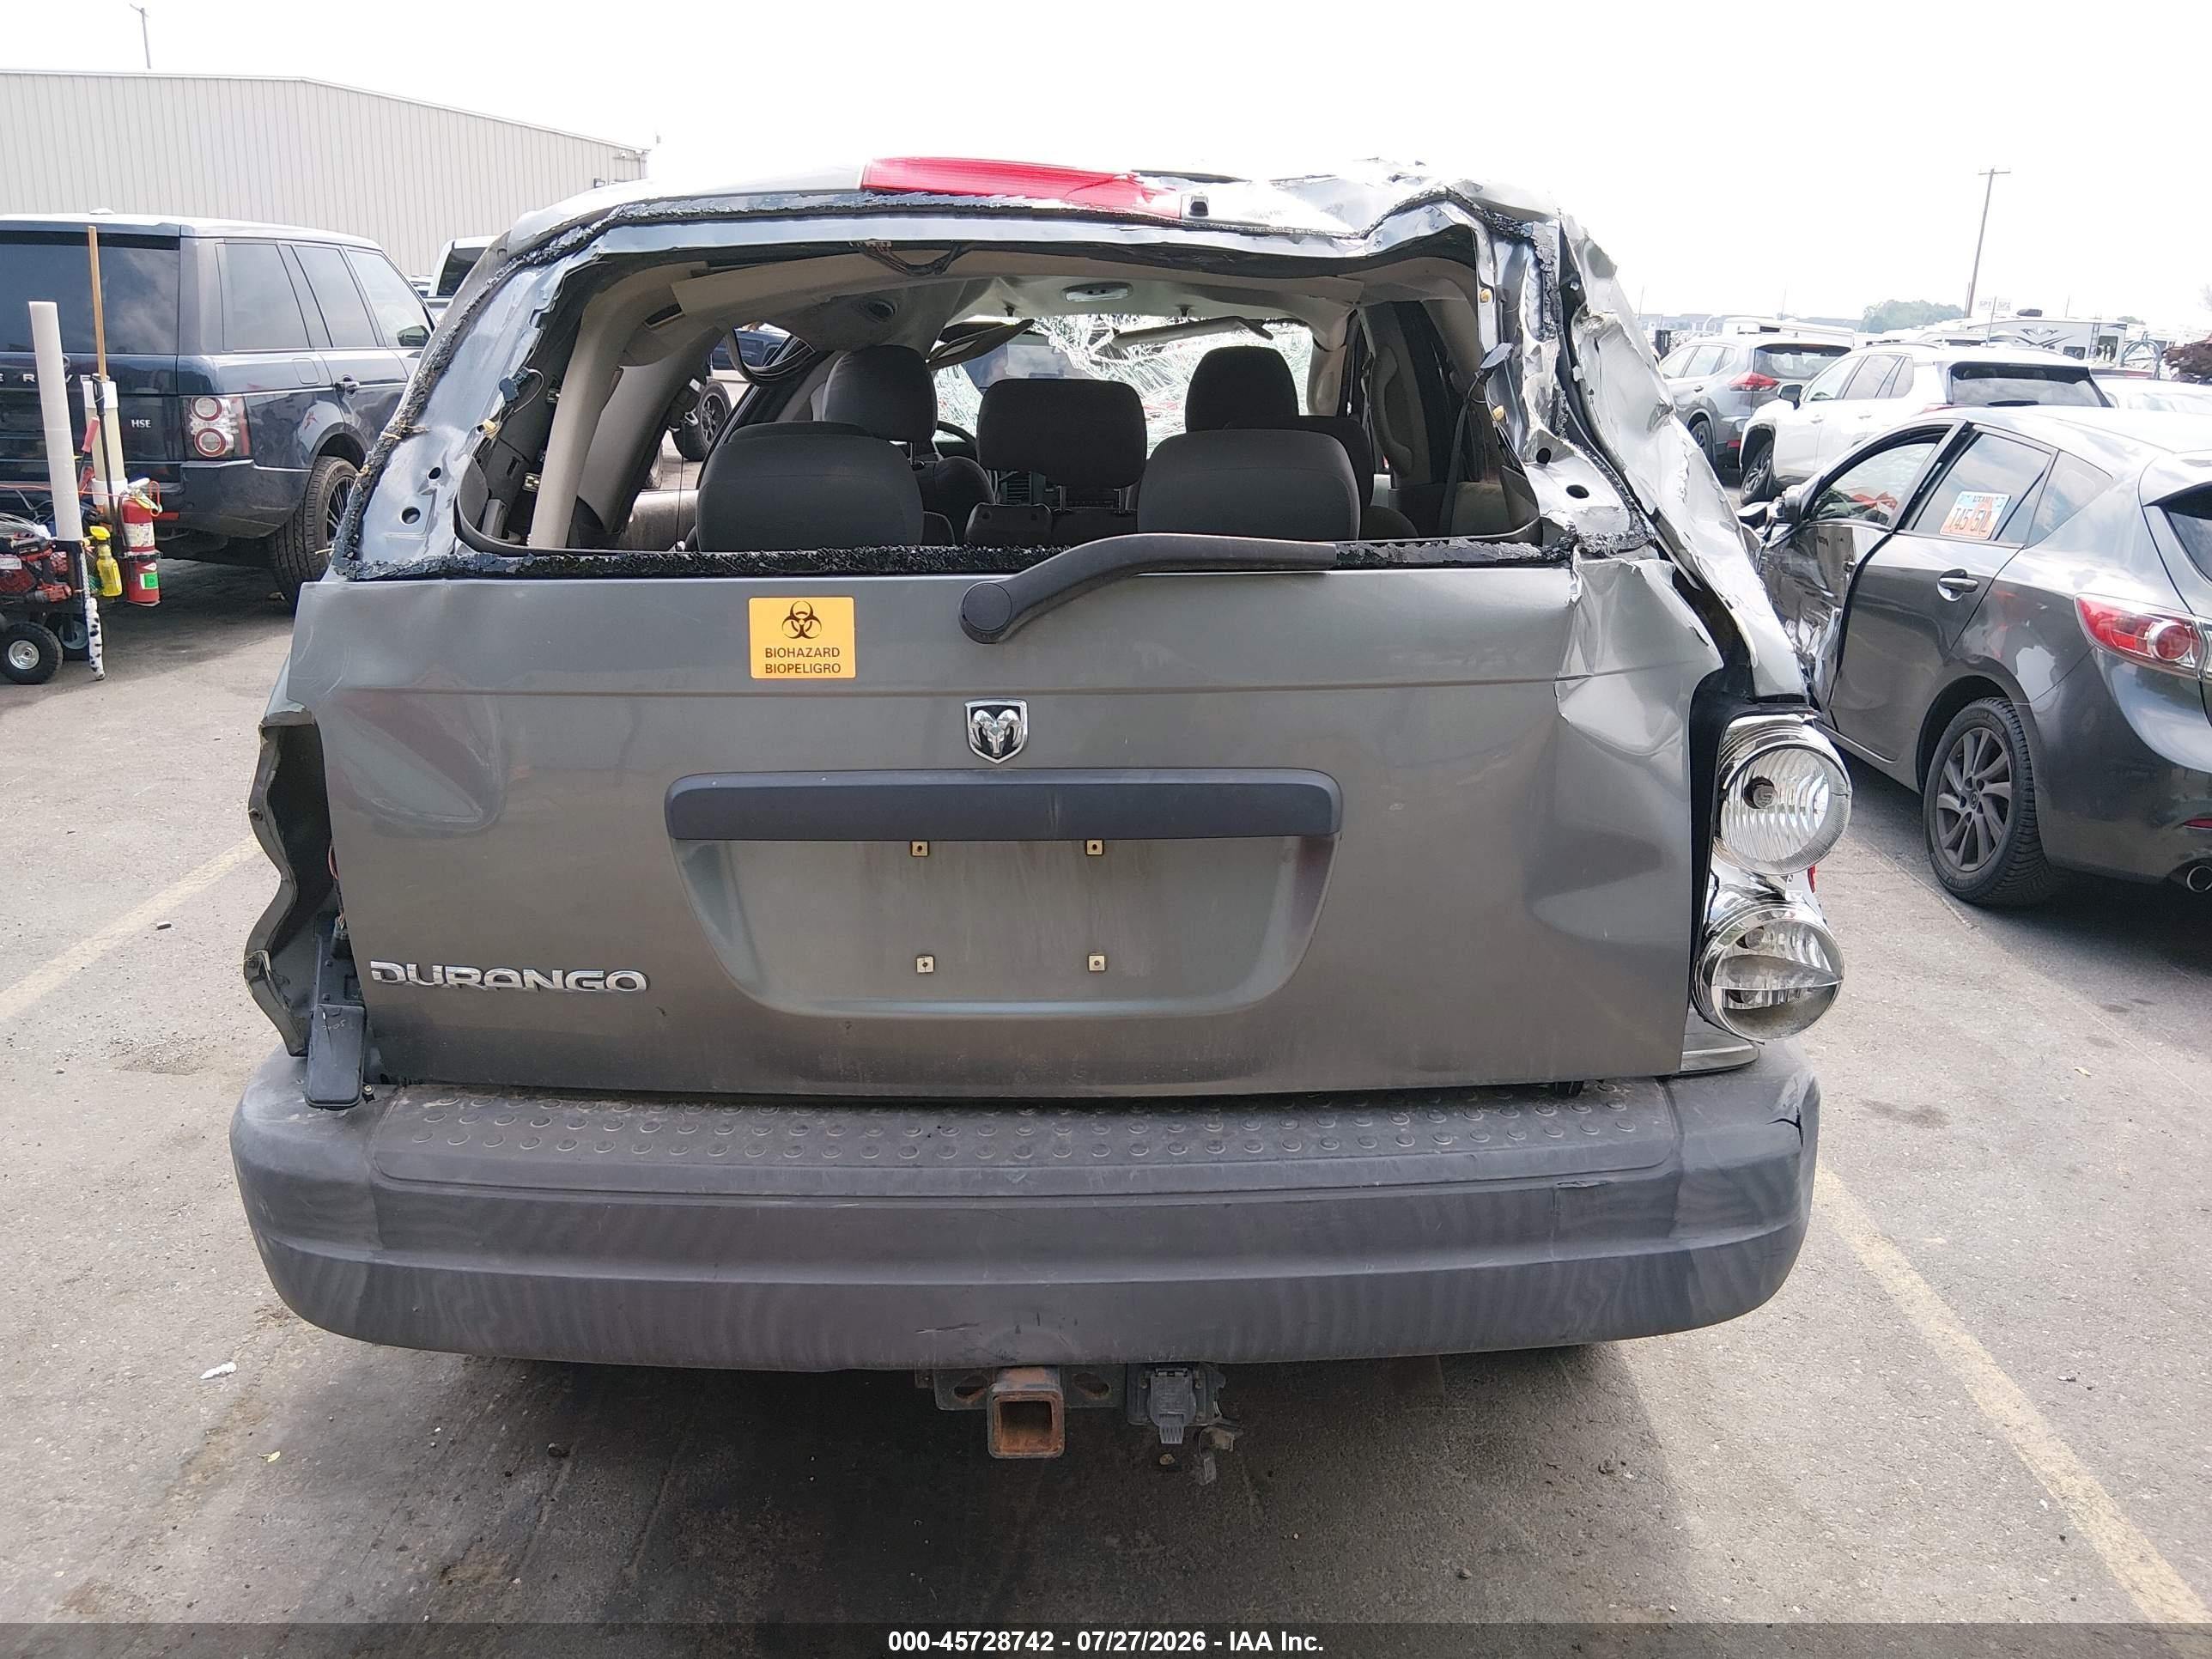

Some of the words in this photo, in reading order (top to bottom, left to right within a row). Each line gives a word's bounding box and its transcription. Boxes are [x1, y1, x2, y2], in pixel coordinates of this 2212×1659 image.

[131, 419, 152, 428] HSE
[765, 647, 840, 658] BIOHAZARD
[765, 663, 841, 674] BIOPELIGRO
[370, 960, 648, 992] DURANGO
